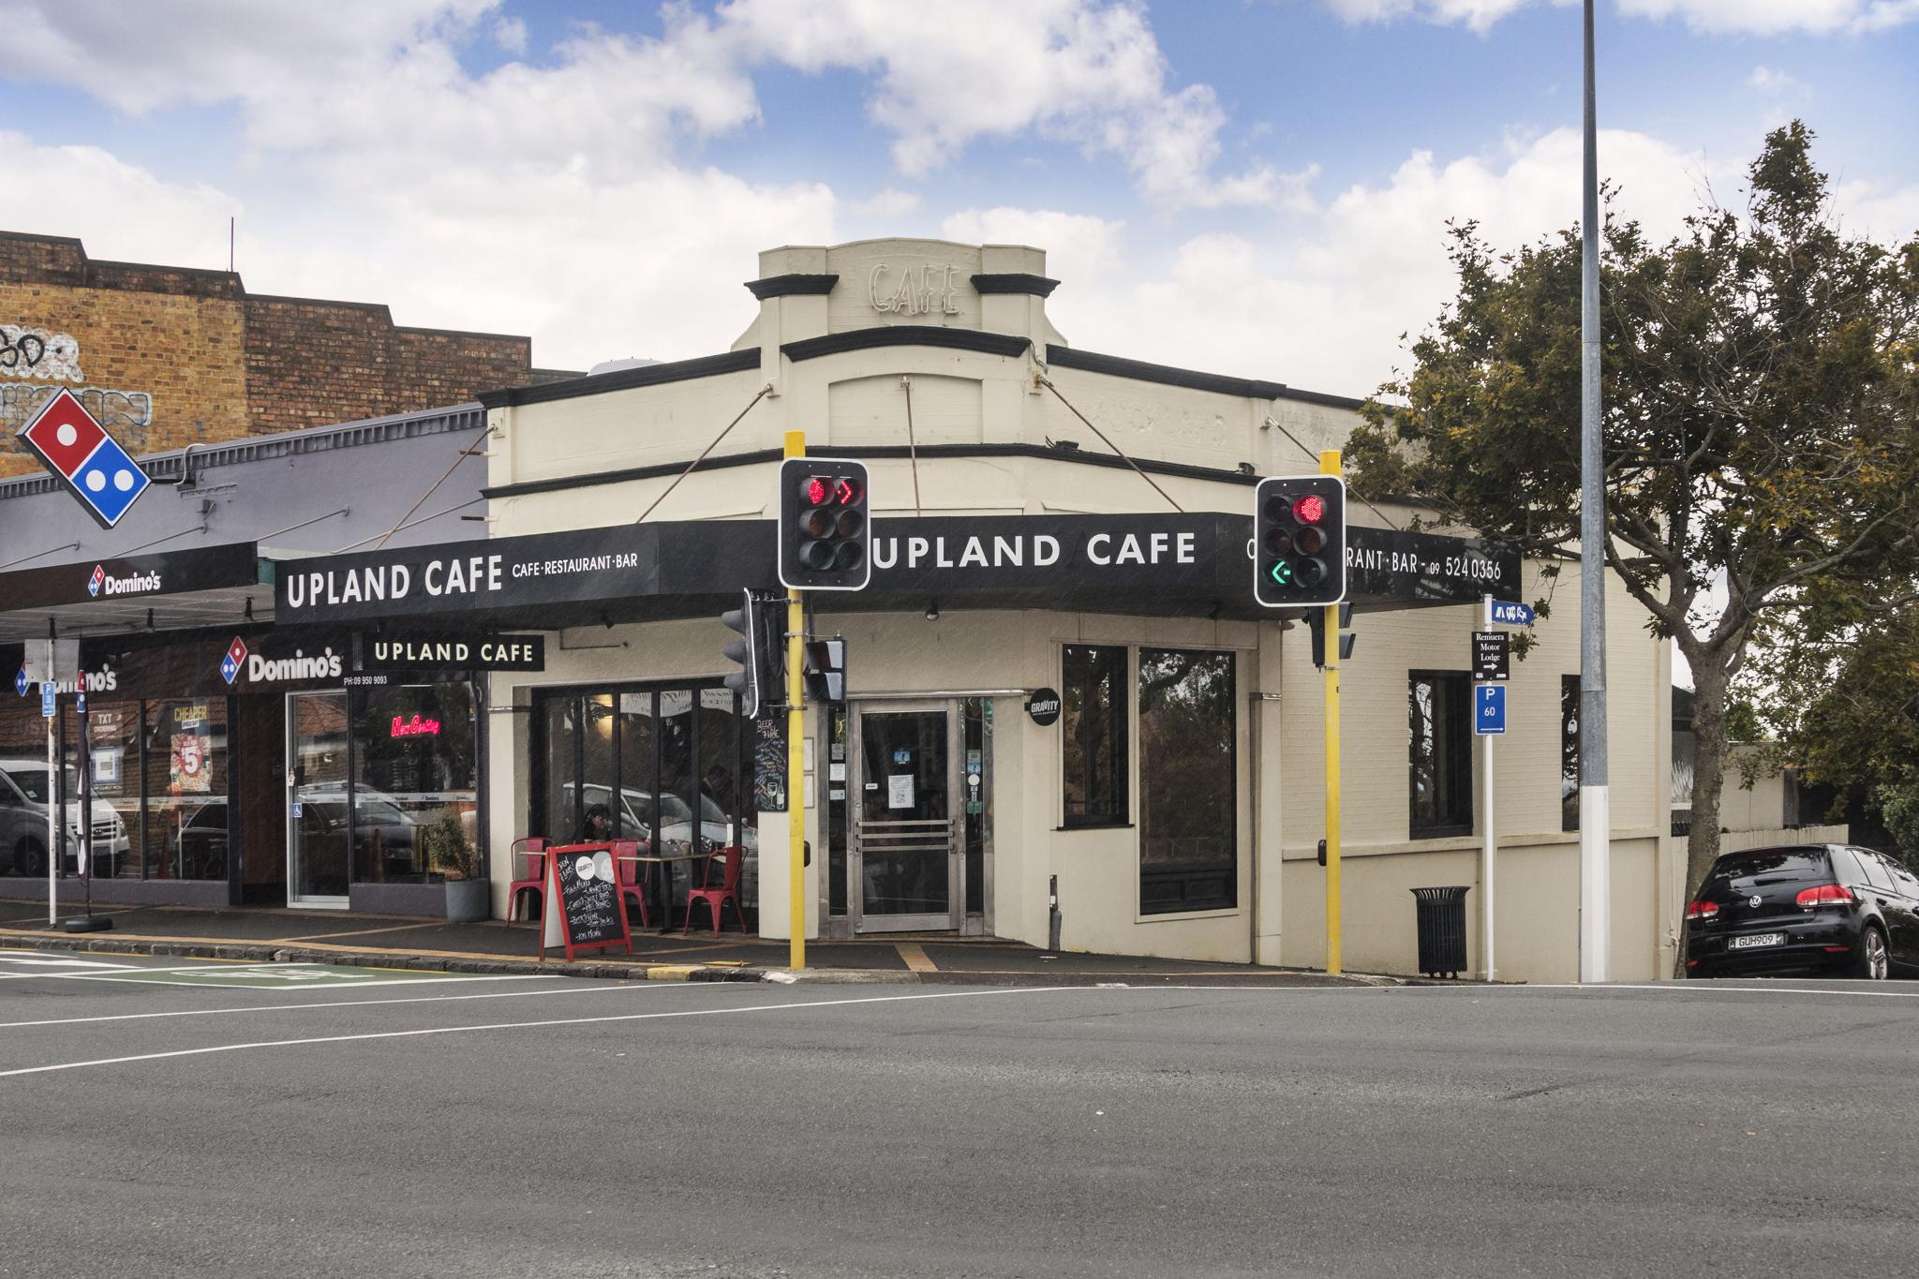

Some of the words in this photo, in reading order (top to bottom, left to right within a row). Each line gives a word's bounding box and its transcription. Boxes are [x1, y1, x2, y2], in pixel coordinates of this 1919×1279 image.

[869, 263, 960, 316] CAFE
[872, 535, 1061, 569] UPLAND
[1087, 533, 1195, 566] CAFE
[1392, 551, 1417, 574] BAR
[1430, 561, 1440, 575] 09
[105, 569, 161, 595] Domino's
[287, 564, 411, 608] UPLAND
[424, 555, 502, 596] CAFE
[1476, 632, 1505, 641] Remuera
[375, 642, 469, 661] UPLAND
[480, 643, 533, 662] CAFE
[1480, 643, 1500, 652] Motor
[248, 646, 343, 683] Domino's
[1480, 653, 1501, 663] Lodge
[1485, 688, 1496, 701] P
[1031, 699, 1059, 713] GRAVITY
[1484, 706, 1496, 717] 60
